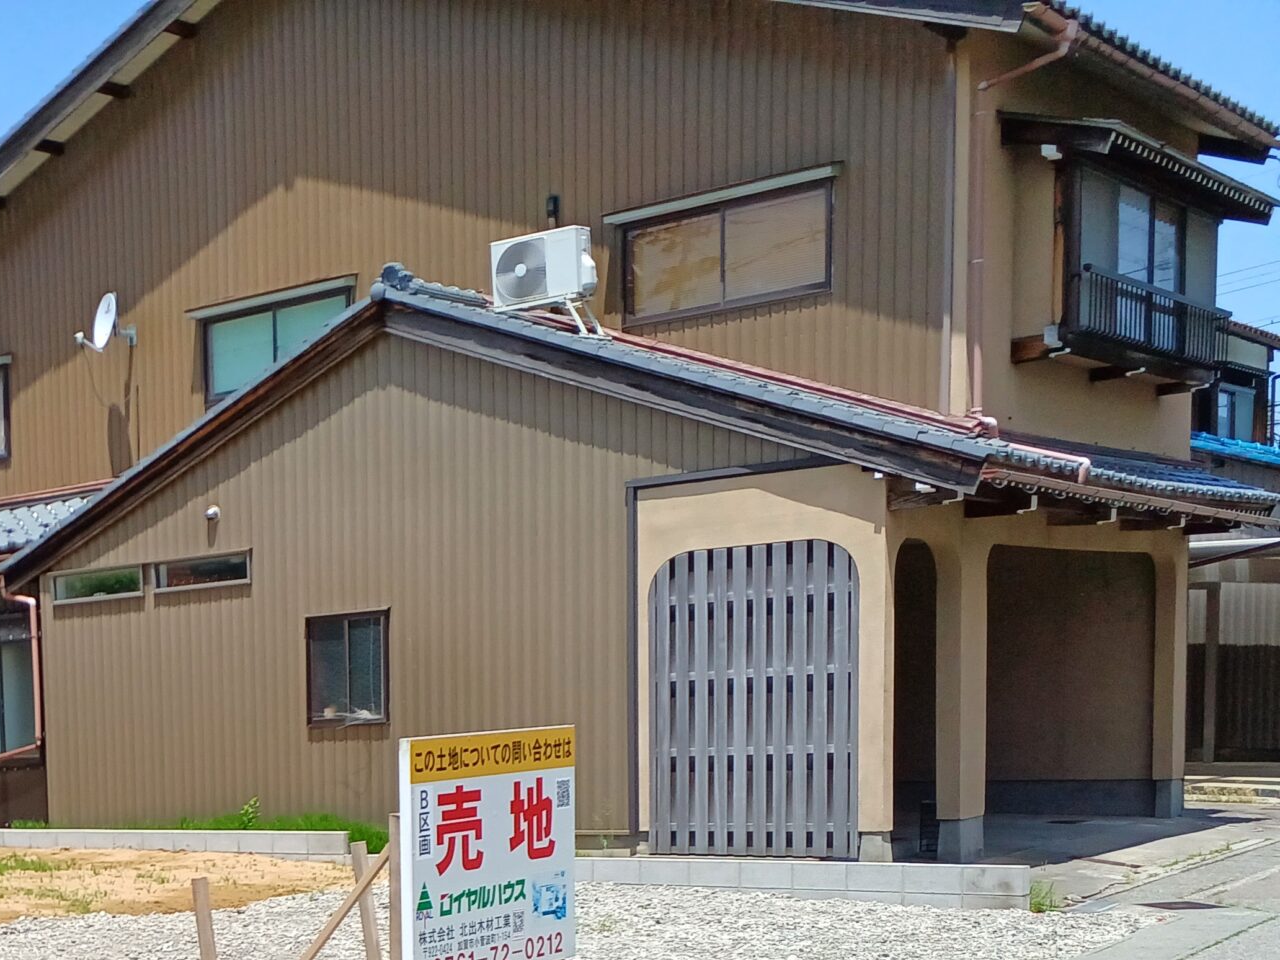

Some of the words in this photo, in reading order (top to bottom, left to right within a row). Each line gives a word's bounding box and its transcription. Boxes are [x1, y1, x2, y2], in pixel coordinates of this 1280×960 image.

[414, 737, 572, 773] この土地についての問い合わせは
[440, 879, 526, 917] ロイヤルハウス
[419, 925, 455, 946] 株式会社
[459, 914, 511, 937] 北出木材工業
